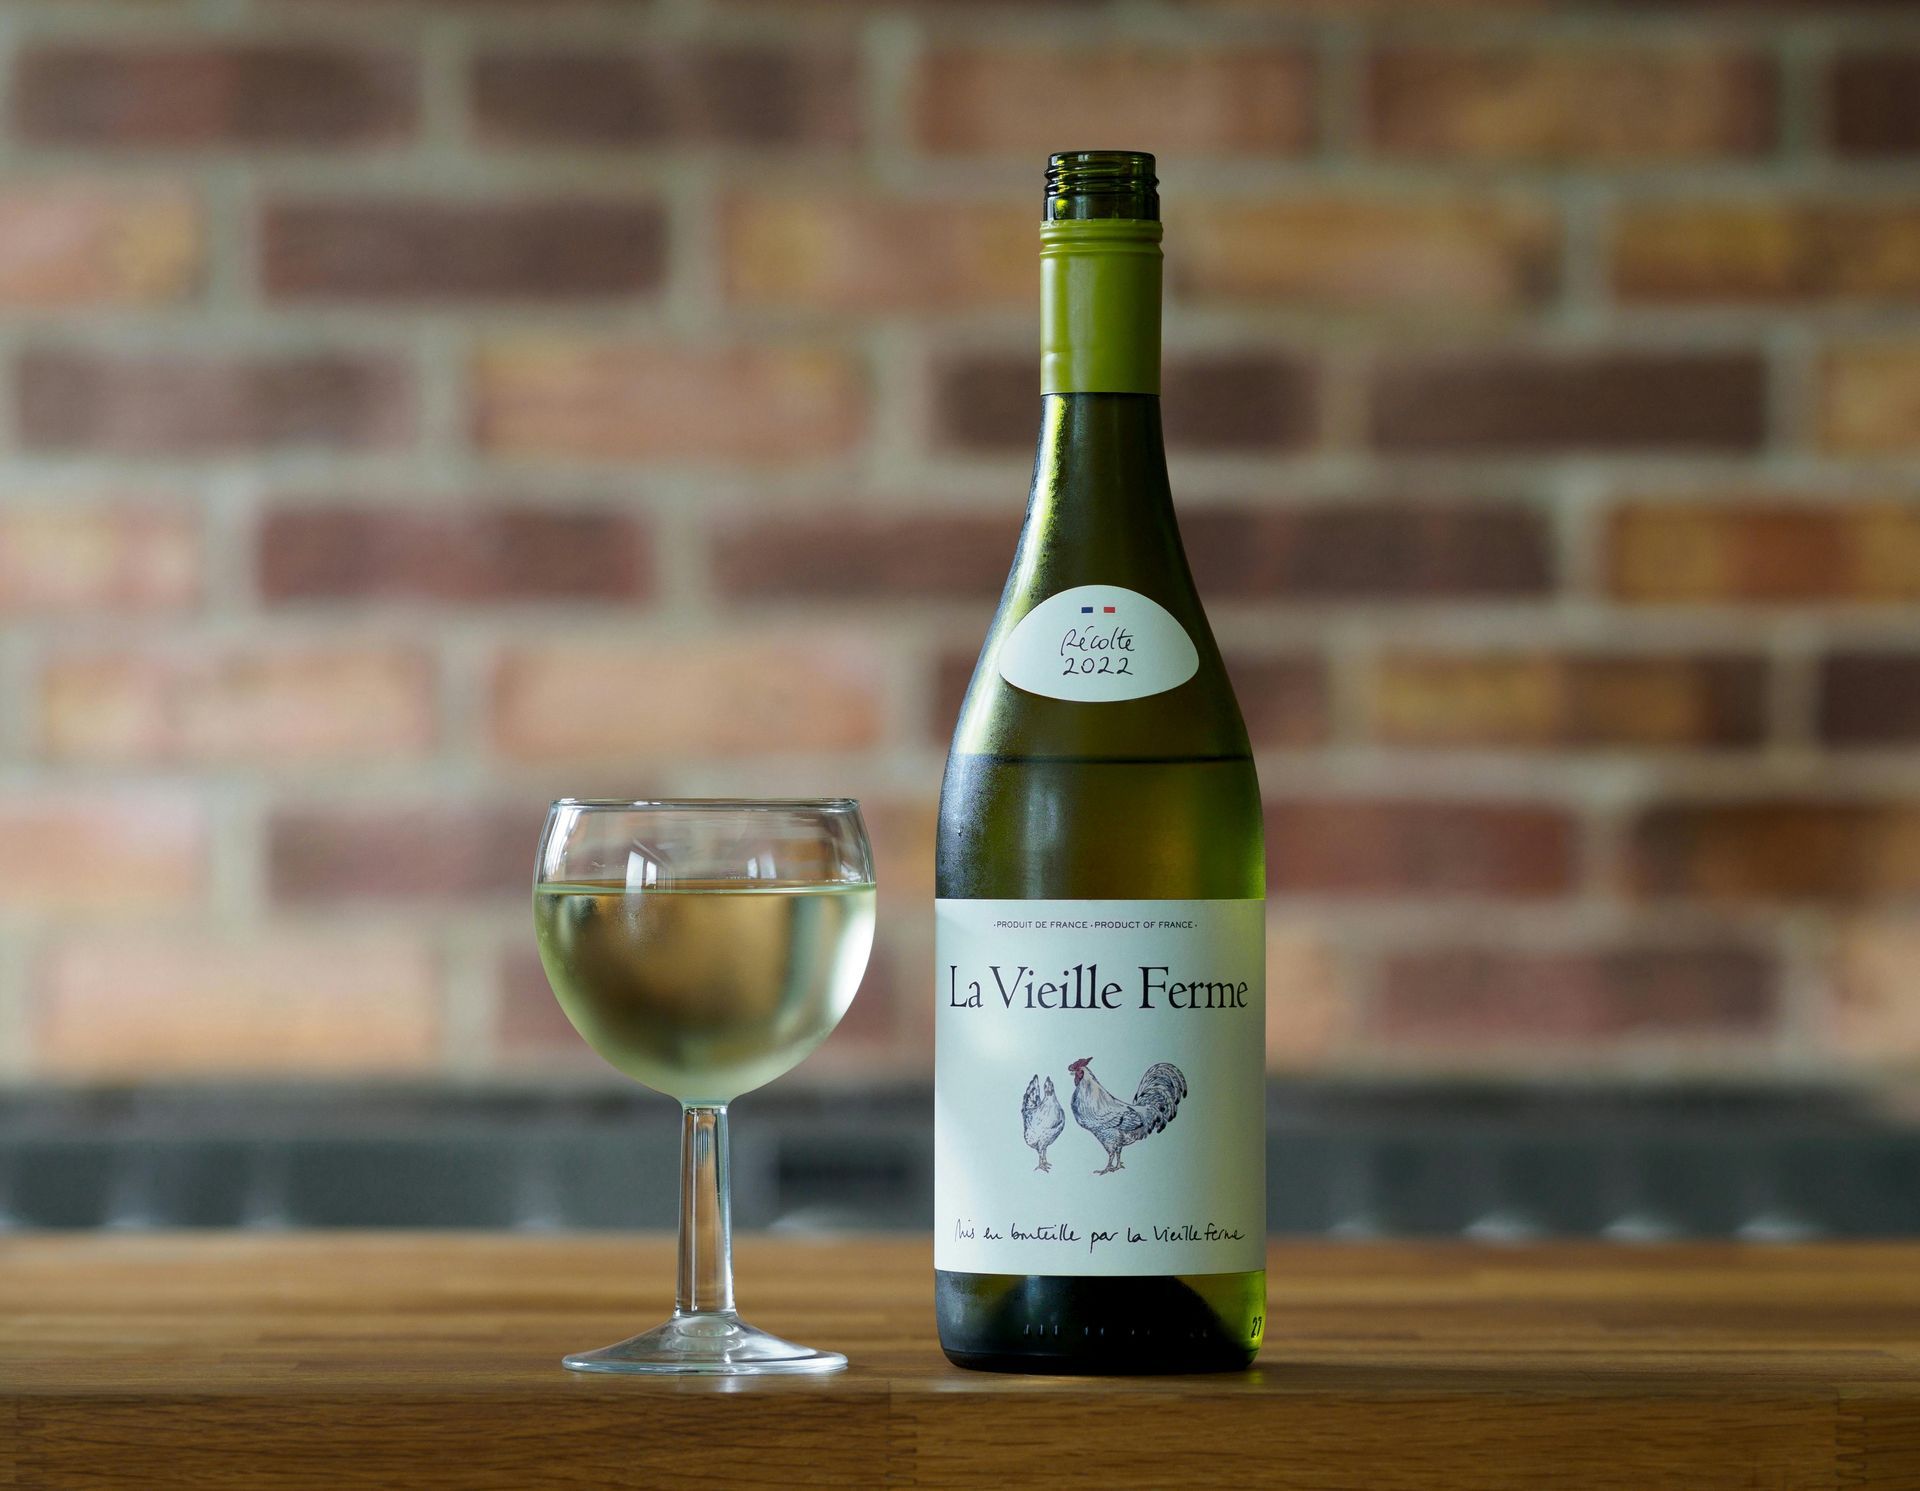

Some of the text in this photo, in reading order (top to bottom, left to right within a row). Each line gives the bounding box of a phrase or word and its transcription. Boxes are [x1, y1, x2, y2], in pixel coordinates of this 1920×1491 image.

[1060, 625, 1135, 656] Récolte
[1062, 656, 1134, 676] 2022
[996, 920, 1193, 929] PRODUIT DE FRANCE PRODUCT OF FRANCE
[950, 963, 1249, 1009] La Vieille Ferme
[983, 1227, 1003, 1240] en
[1010, 1222, 1081, 1241] bouteille
[1088, 1231, 1119, 1253] par
[1127, 1227, 1147, 1243] la
